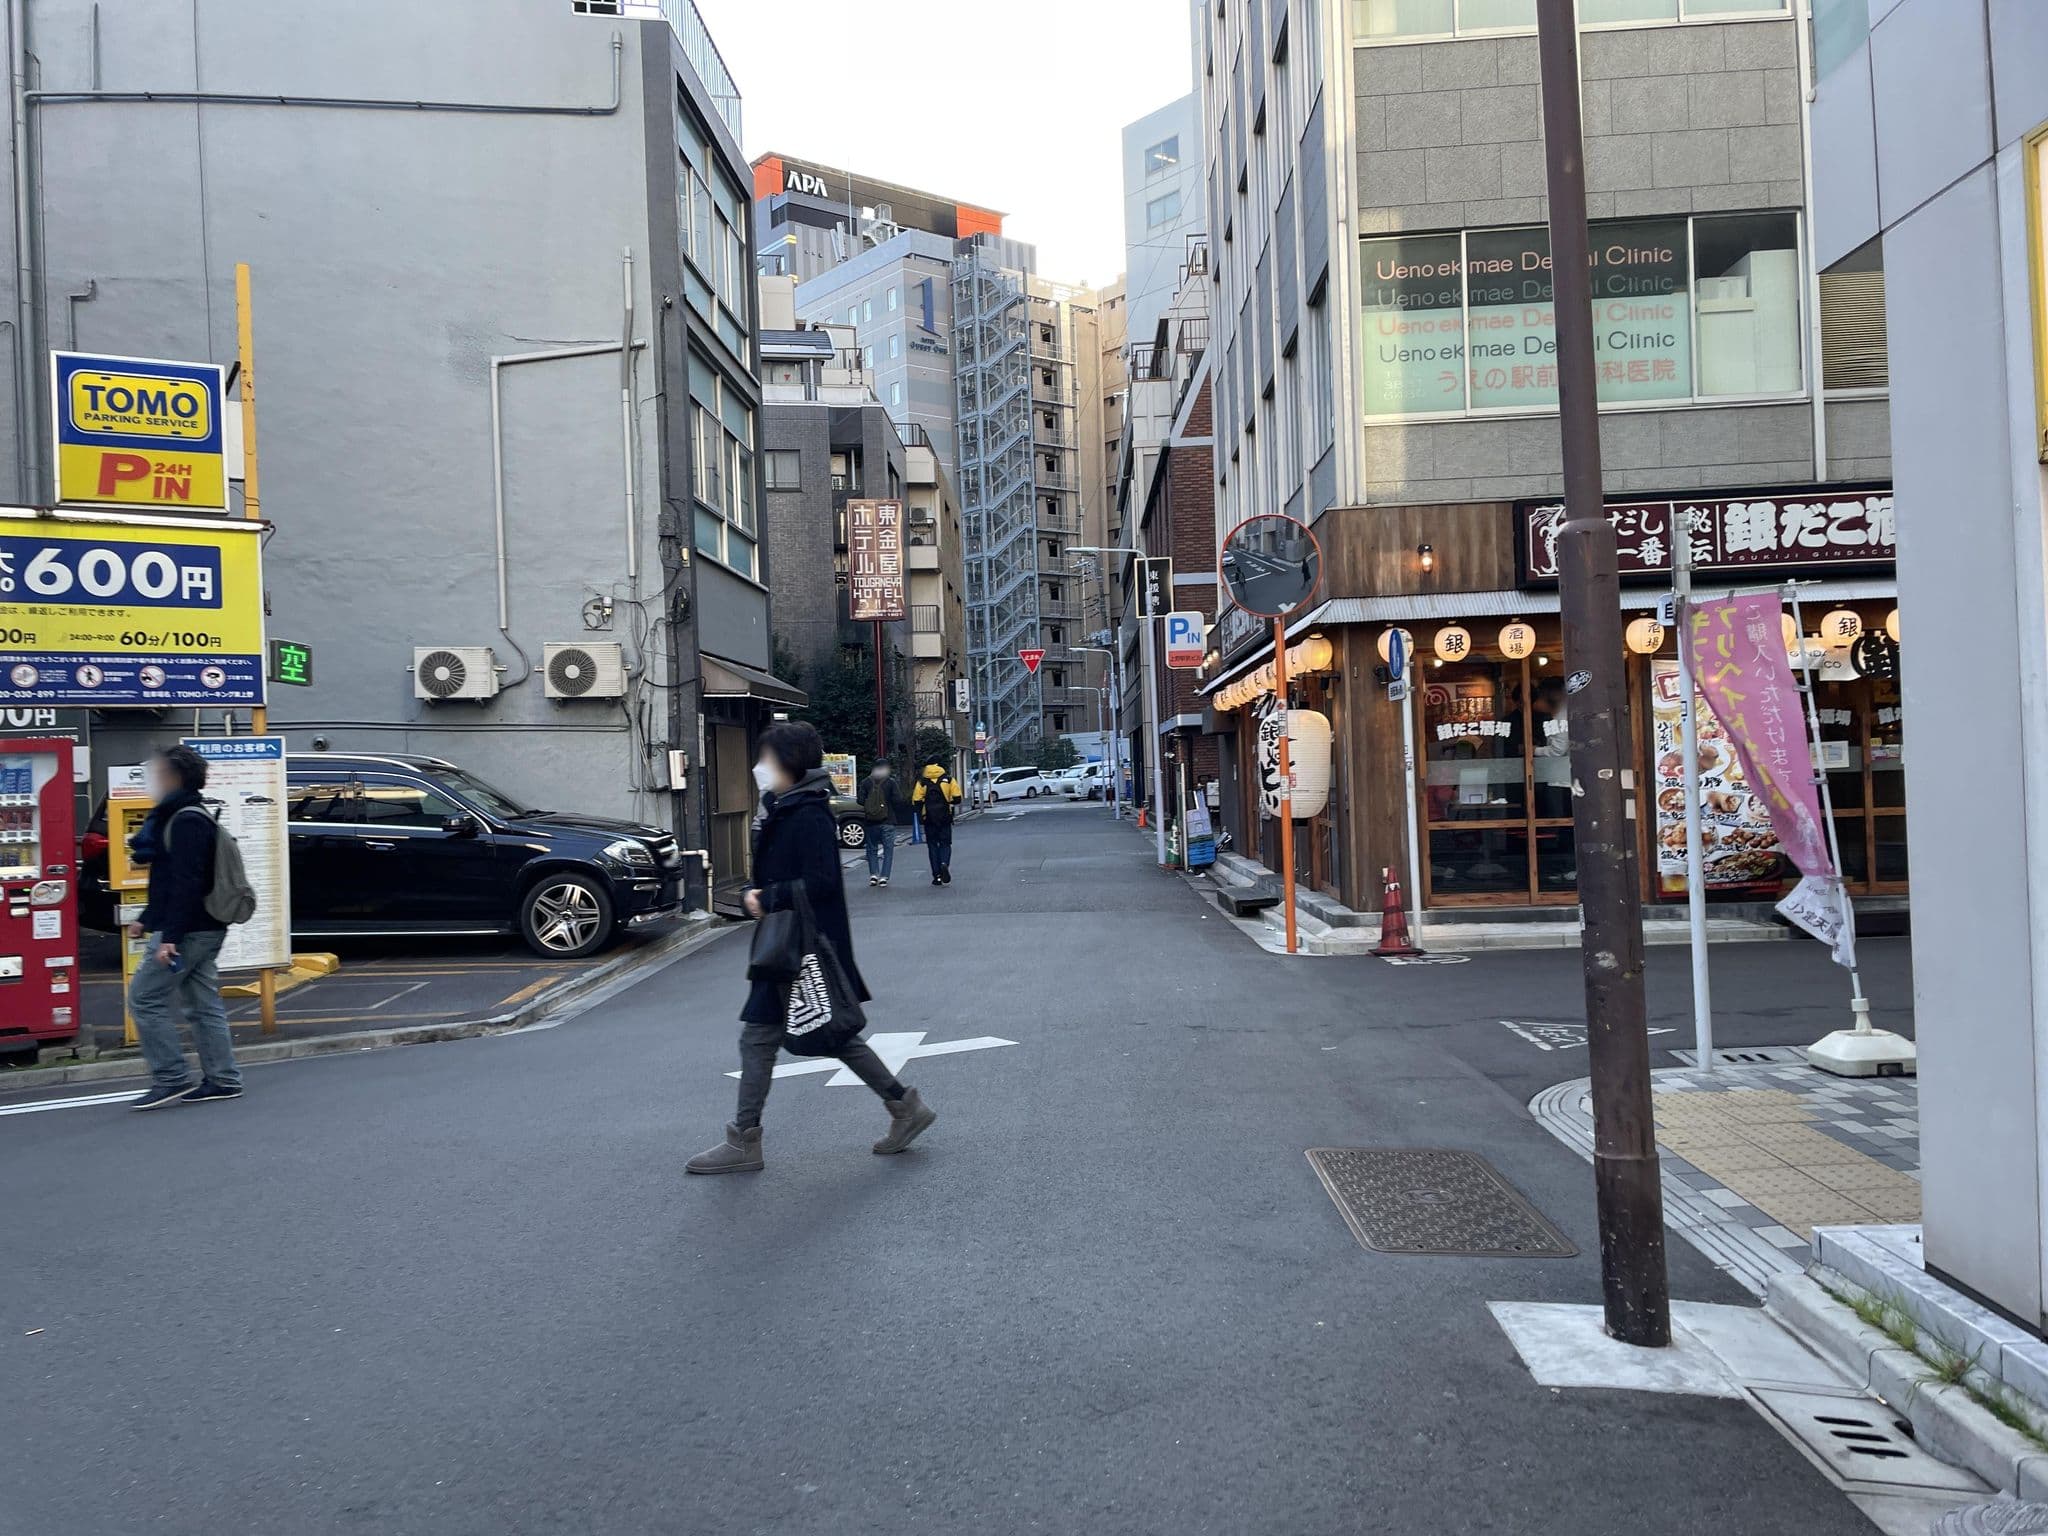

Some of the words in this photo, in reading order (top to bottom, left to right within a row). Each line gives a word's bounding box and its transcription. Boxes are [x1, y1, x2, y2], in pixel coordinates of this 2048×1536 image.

[787, 170, 828, 197] APA
[1606, 246, 1673, 265] Clinic
[1607, 274, 1673, 293] Clinic
[1608, 331, 1675, 350] Clinic
[1438, 358, 1676, 392] うえの駅前科医院
[82, 384, 199, 418] TOMO
[84, 412, 141, 425] PARKING
[146, 416, 198, 429] SERVICE
[97, 452, 151, 497] P
[154, 462, 193, 476] 24H
[153, 477, 191, 500] IN
[1607, 509, 1664, 537] だし
[853, 504, 874, 575] ホテル
[878, 504, 899, 574] 東金屋
[1616, 536, 1668, 566] 一番
[1728, 552, 1799, 561] TSUKIJI
[1812, 548, 1890, 558] GINDACO
[853, 588, 903, 599] HOTEL
[1839, 618, 1858, 636] 銀
[1445, 634, 1465, 653] 銀
[1509, 628, 1524, 655] 酒場
[280, 646, 306, 682] 空
[1437, 720, 1512, 741] 銀だこ酒場
